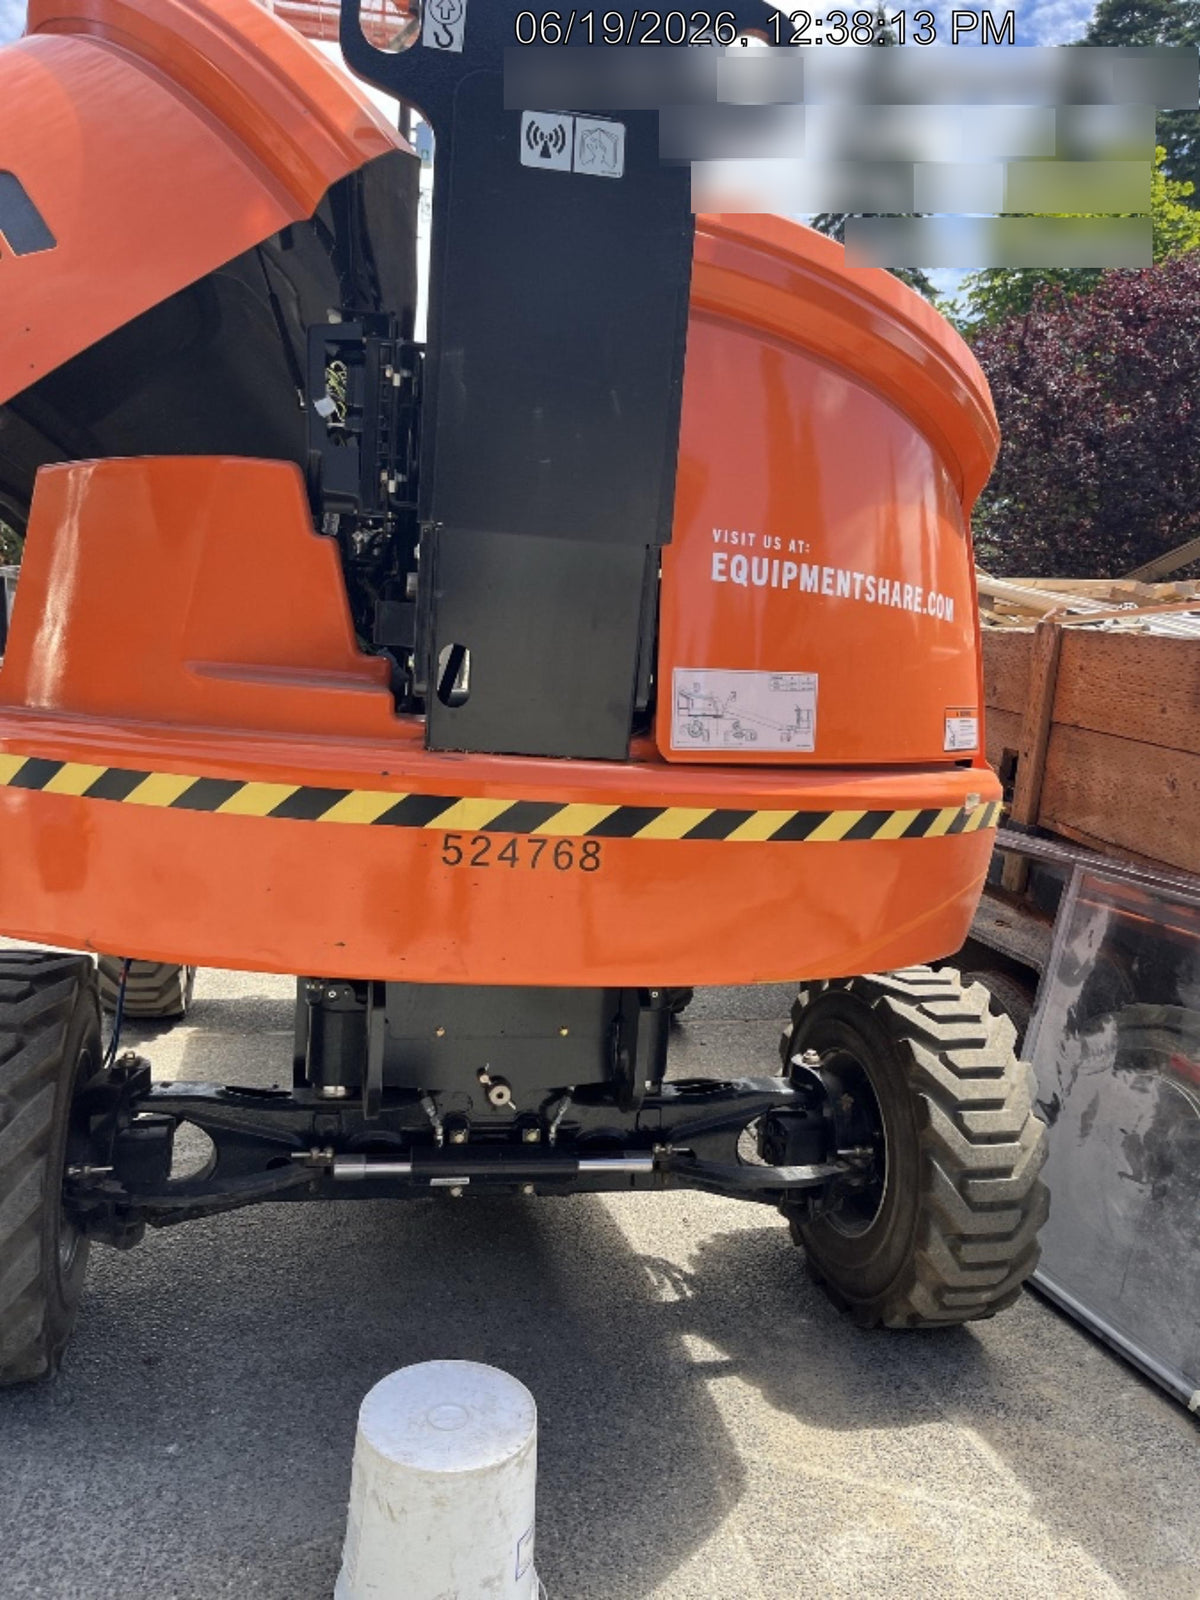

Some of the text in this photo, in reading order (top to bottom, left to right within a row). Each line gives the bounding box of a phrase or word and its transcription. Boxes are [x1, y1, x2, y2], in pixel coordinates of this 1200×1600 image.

[712, 528, 810, 554] VISIT US AT:
[711, 551, 954, 623] EQUIPMENTSHARE.COM
[441, 833, 602, 872] 524768
